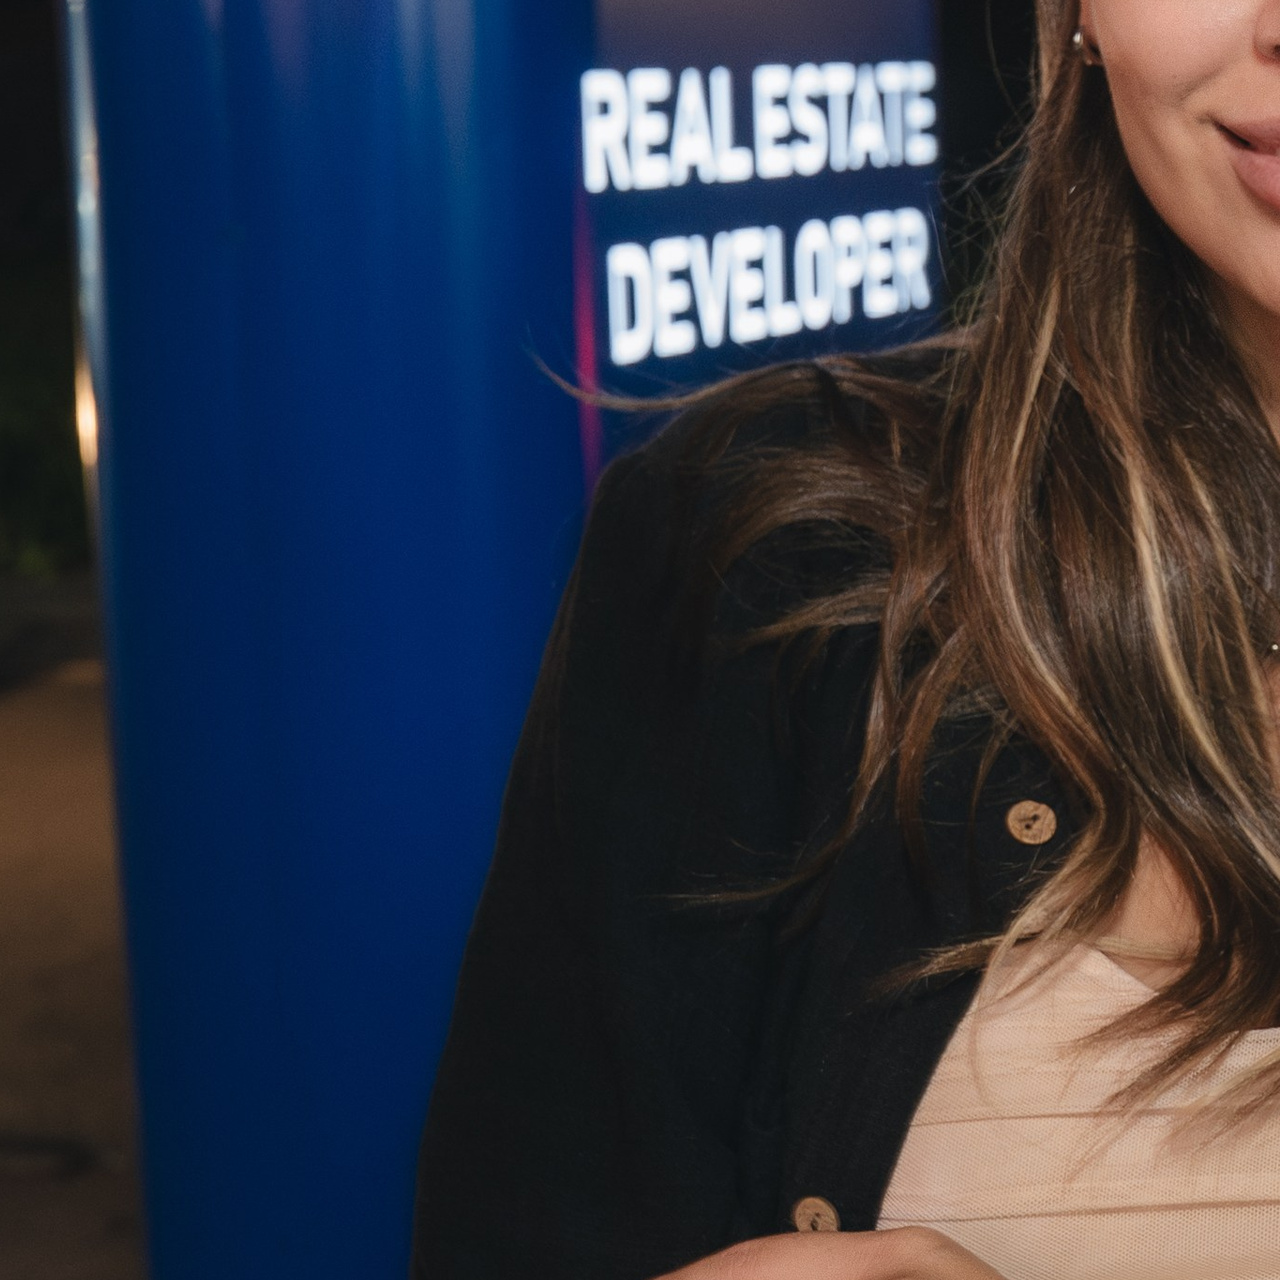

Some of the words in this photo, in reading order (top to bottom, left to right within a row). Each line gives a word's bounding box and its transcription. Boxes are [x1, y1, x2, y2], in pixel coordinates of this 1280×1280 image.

[580, 65, 754, 194] REAL
[751, 60, 939, 180] ESTATE
[606, 207, 932, 366] DEVELOPER
